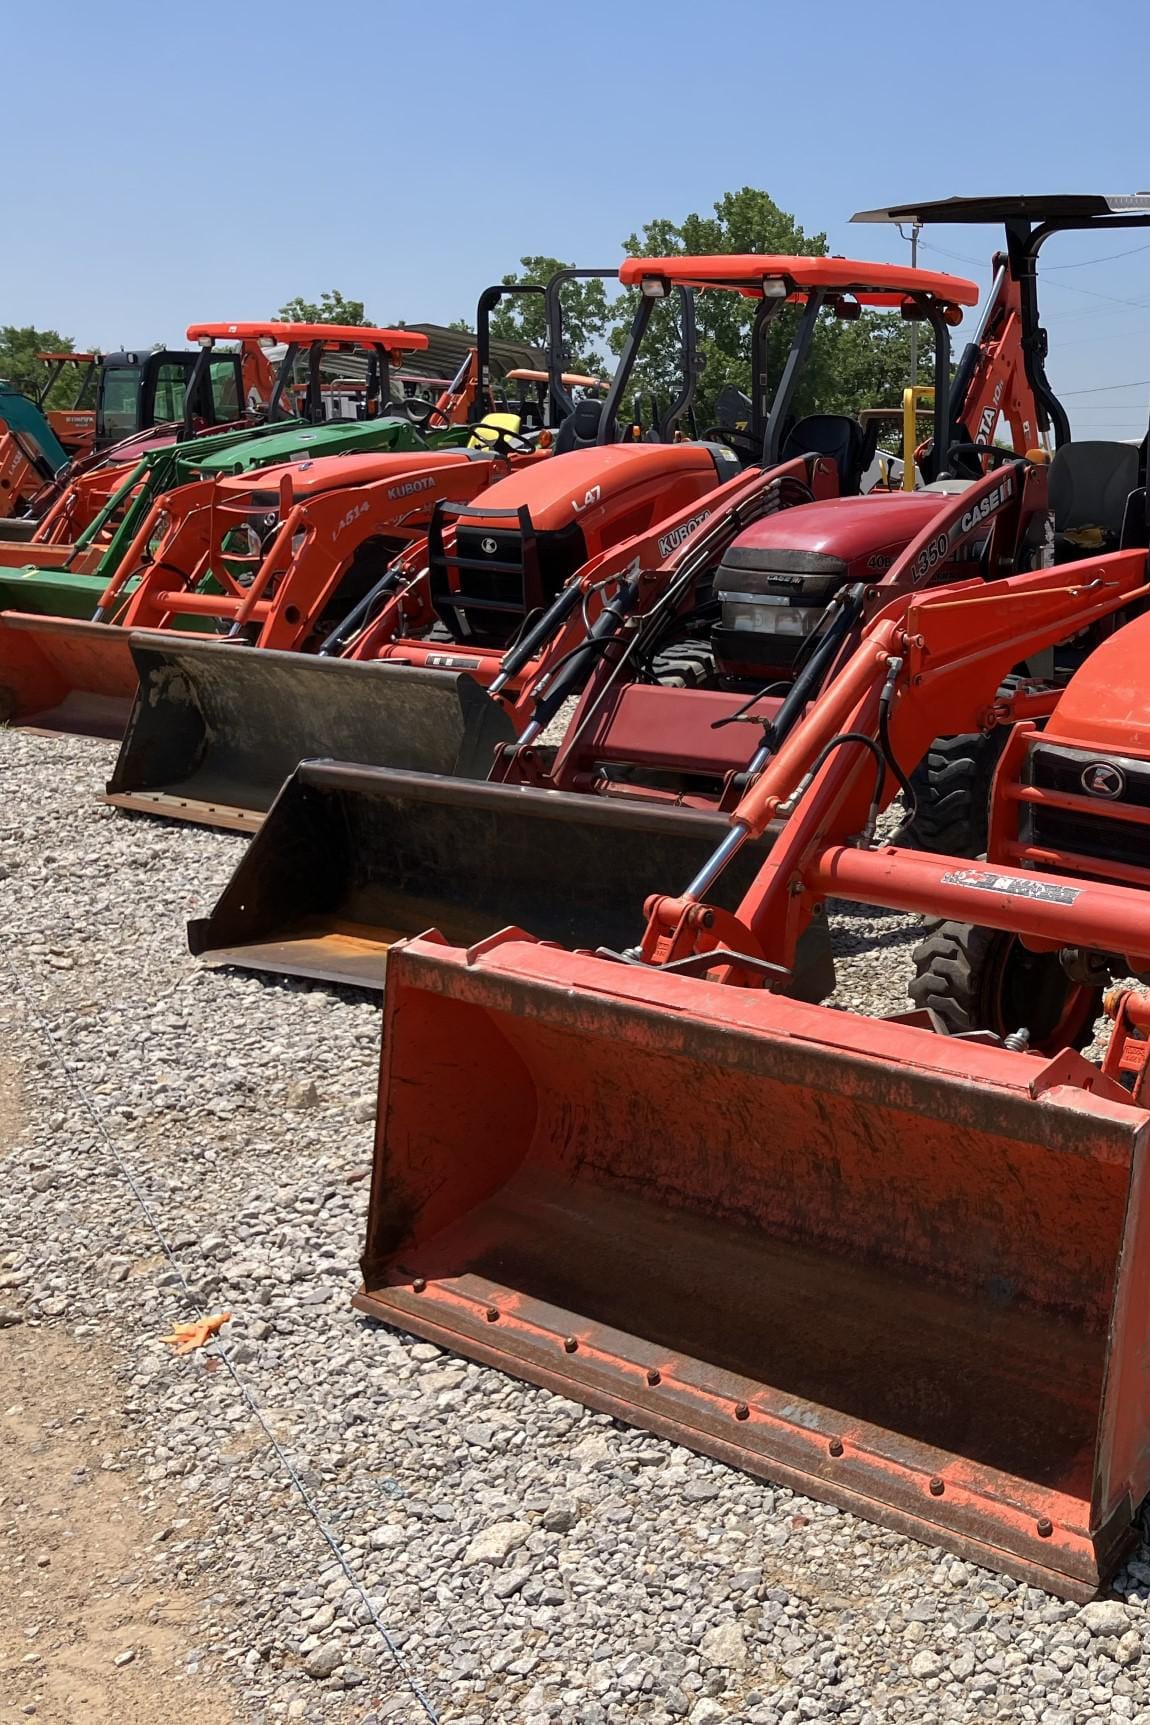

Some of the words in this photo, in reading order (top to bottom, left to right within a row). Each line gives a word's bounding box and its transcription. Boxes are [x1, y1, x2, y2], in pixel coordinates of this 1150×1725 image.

[387, 476, 436, 500] KUBOTA
[571, 484, 601, 513] L47
[961, 488, 1000, 532] CASE
[911, 532, 949, 584] L350
